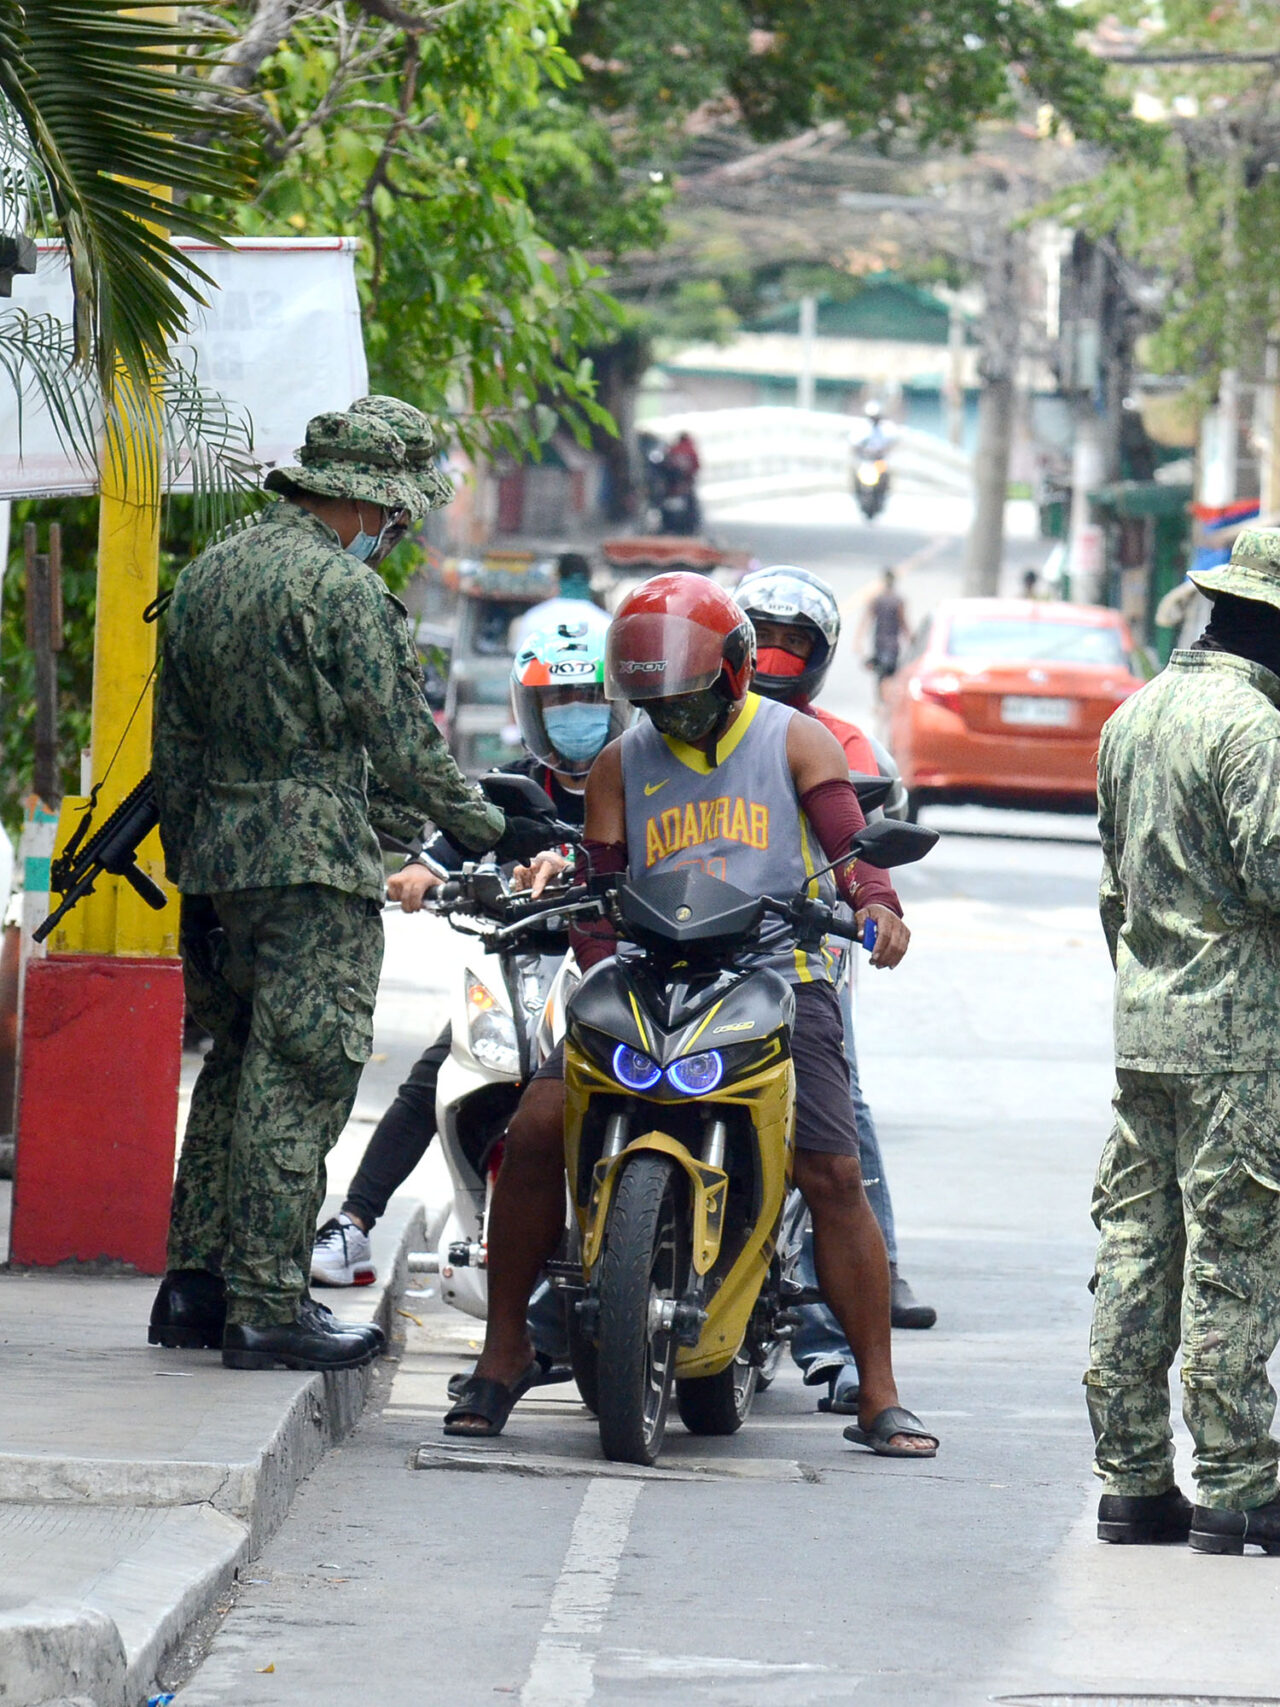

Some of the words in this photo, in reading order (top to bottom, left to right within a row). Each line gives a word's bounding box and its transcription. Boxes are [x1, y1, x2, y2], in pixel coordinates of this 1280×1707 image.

[552, 661, 593, 674] KYT
[619, 660, 668, 674] XPOT
[646, 796, 769, 869] ADAKRAB
